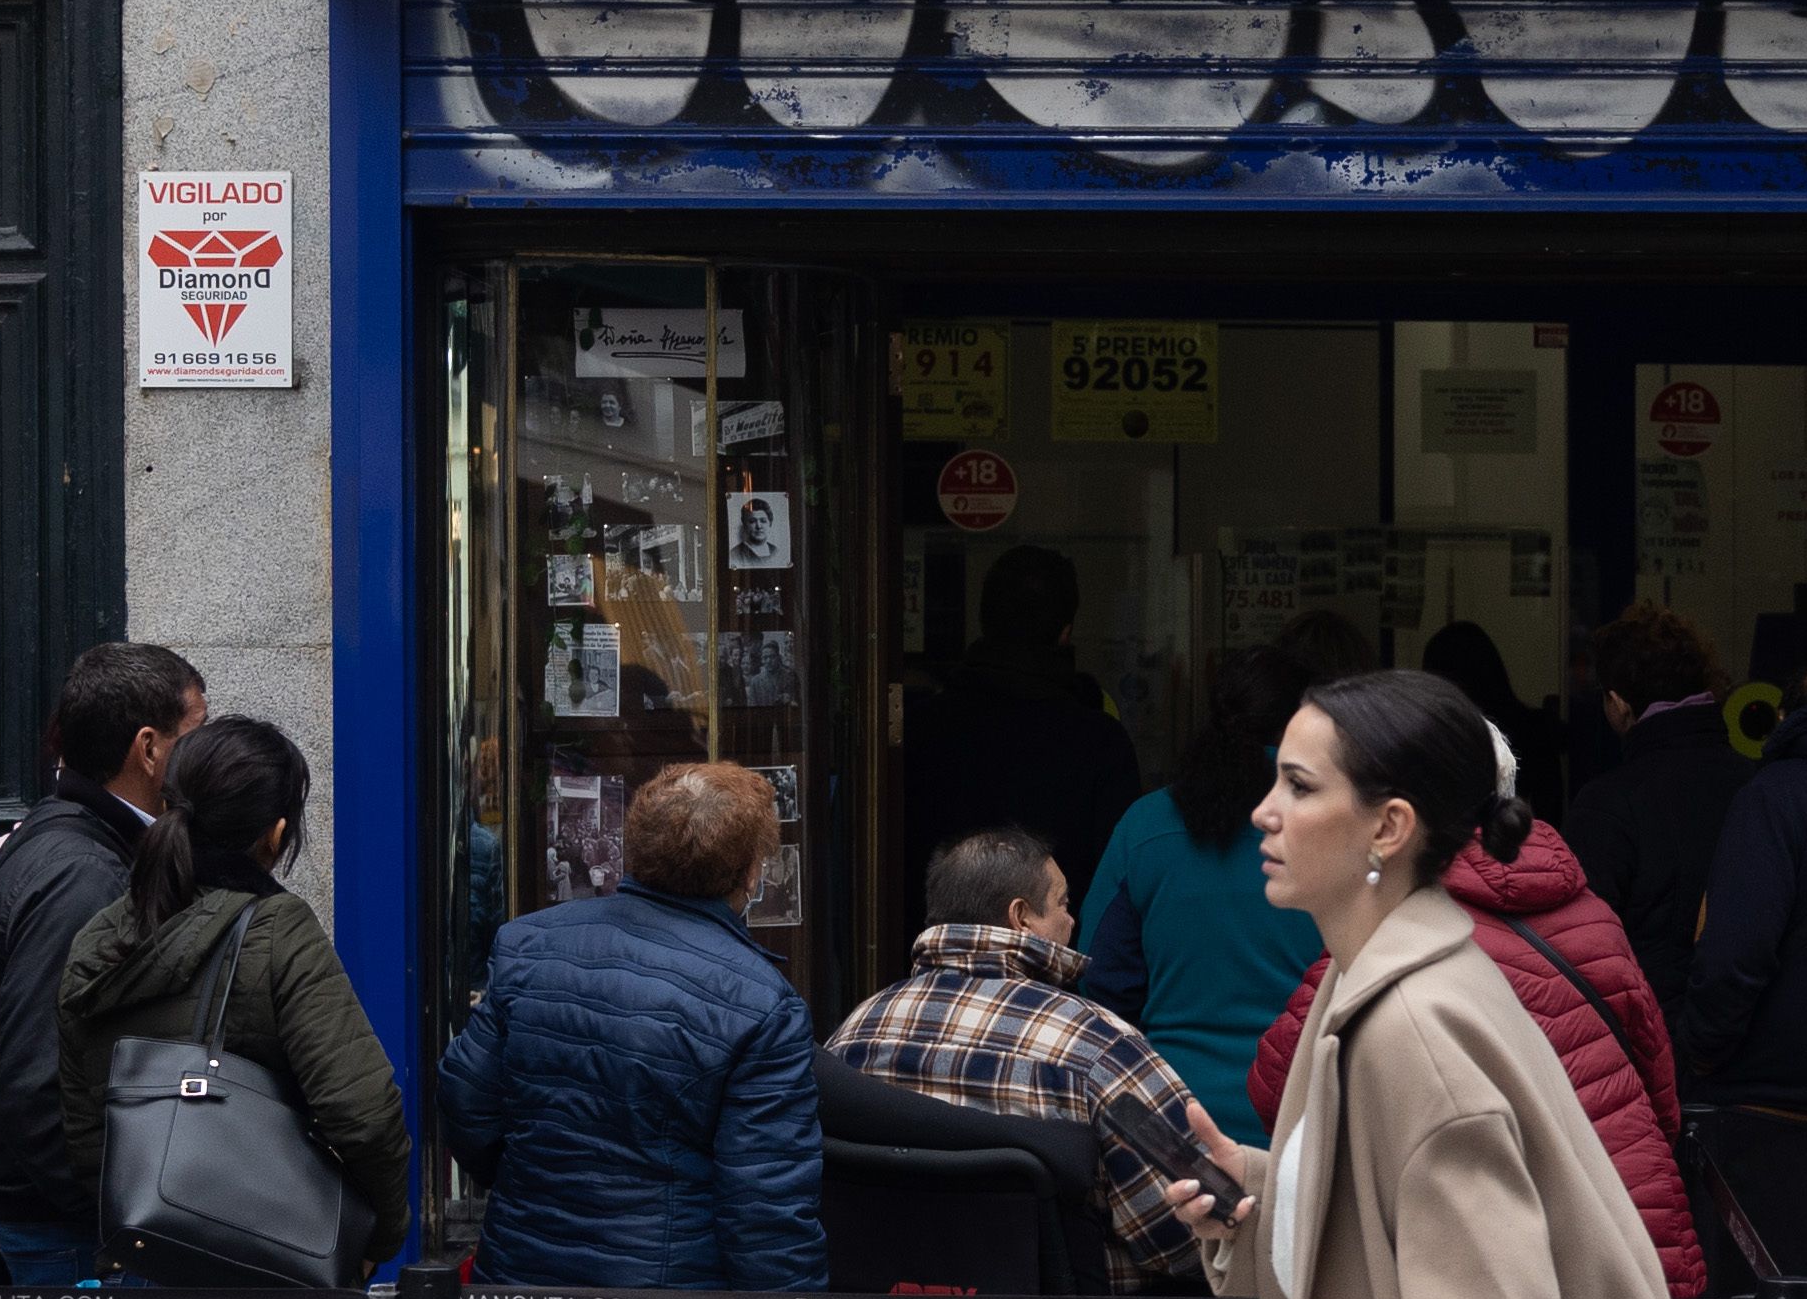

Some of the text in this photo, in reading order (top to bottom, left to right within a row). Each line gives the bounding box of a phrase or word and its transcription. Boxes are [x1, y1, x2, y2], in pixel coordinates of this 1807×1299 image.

[149, 182, 283, 204] VIGILADO
[203, 212, 227, 224] por
[181, 291, 248, 300] SEGURIDAD
[907, 327, 979, 347] REMIO
[1096, 336, 1197, 356] PREMIO
[154, 353, 277, 365] 91 669 16 56
[905, 349, 993, 377] 914
[147, 367, 285, 377] www.diamondseguridad.com
[1063, 356, 1209, 392] 92052
[1665, 389, 1705, 413] +18
[954, 459, 998, 485] +18
[1225, 589, 1296, 610] 75.481
